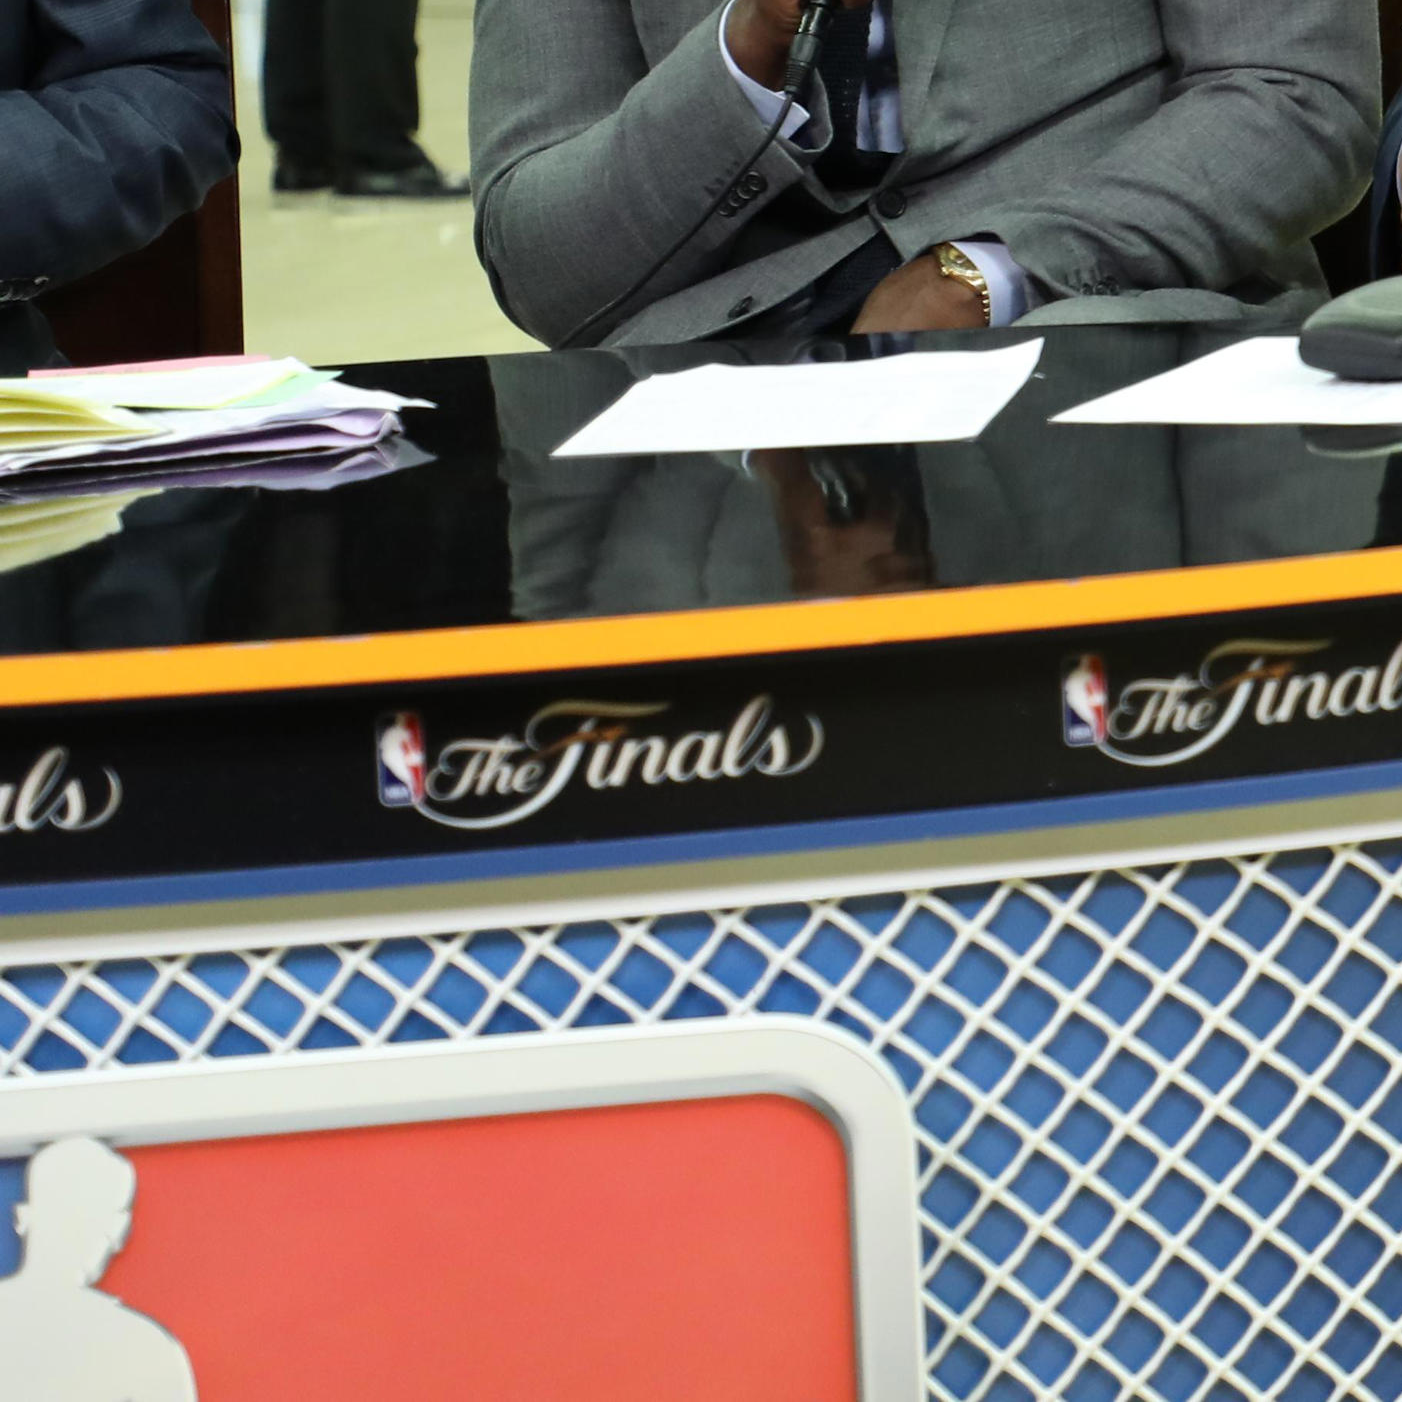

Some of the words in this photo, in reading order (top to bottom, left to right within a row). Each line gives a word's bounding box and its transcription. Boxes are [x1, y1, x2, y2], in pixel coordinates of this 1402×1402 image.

[1107, 674, 1216, 740] The
[415, 694, 824, 829] Finals
[425, 734, 546, 801] The
